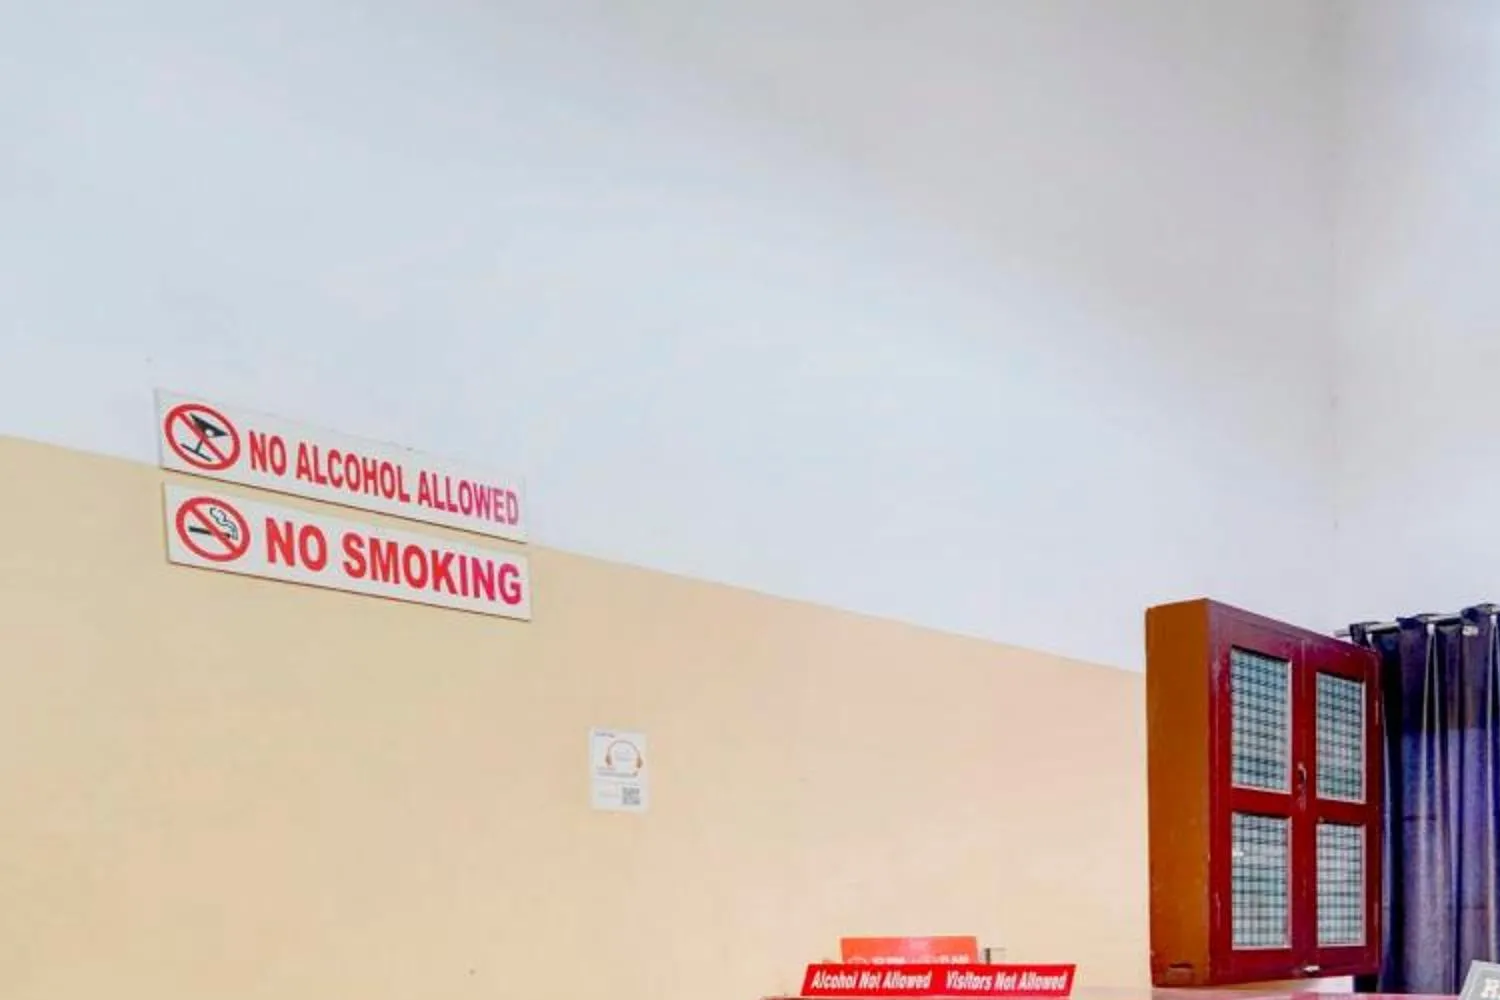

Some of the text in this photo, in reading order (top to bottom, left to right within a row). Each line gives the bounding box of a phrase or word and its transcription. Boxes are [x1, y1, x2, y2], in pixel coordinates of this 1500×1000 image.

[249, 429, 520, 527] NO ALCOHOL ALLOWED
[264, 516, 523, 606] NO SMOKING
[810, 970, 1067, 991] Alcohol Not Allowed Visitors Not Allowed
